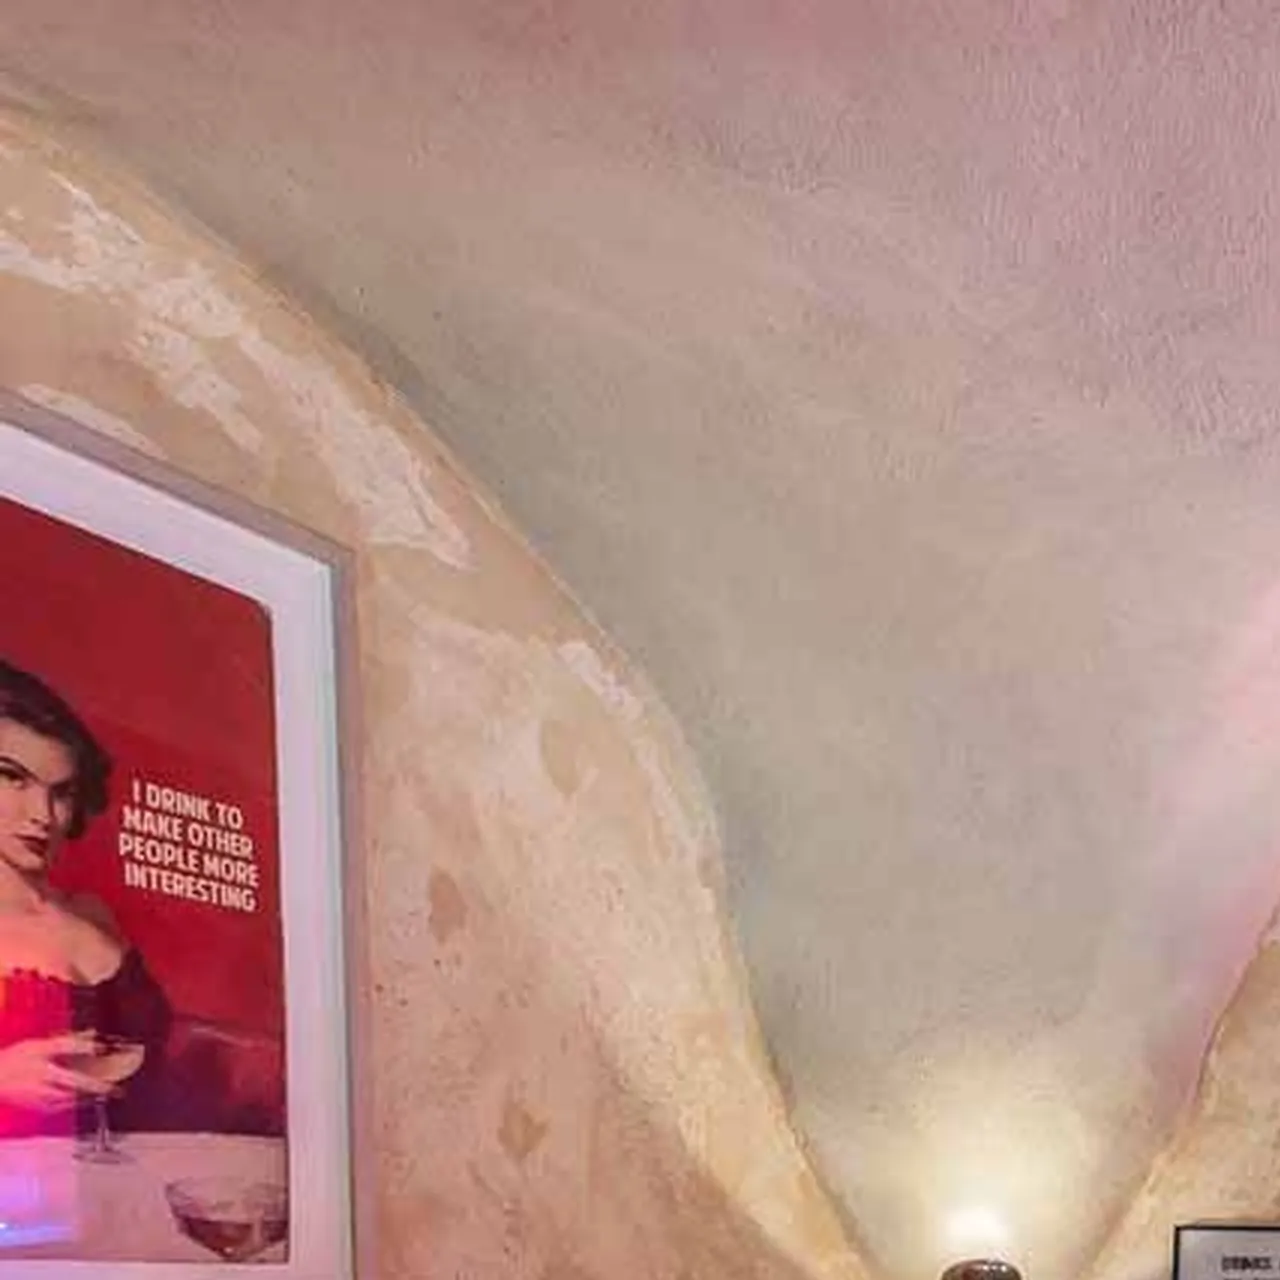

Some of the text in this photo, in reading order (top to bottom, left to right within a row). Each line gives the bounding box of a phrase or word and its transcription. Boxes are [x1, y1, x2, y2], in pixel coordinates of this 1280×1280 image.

[133, 778, 243, 829] I DRINK TO
[122, 805, 254, 861] MAKE OTHER
[118, 832, 260, 888] PEOPLE MORE
[124, 862, 257, 913] INTERESTING
